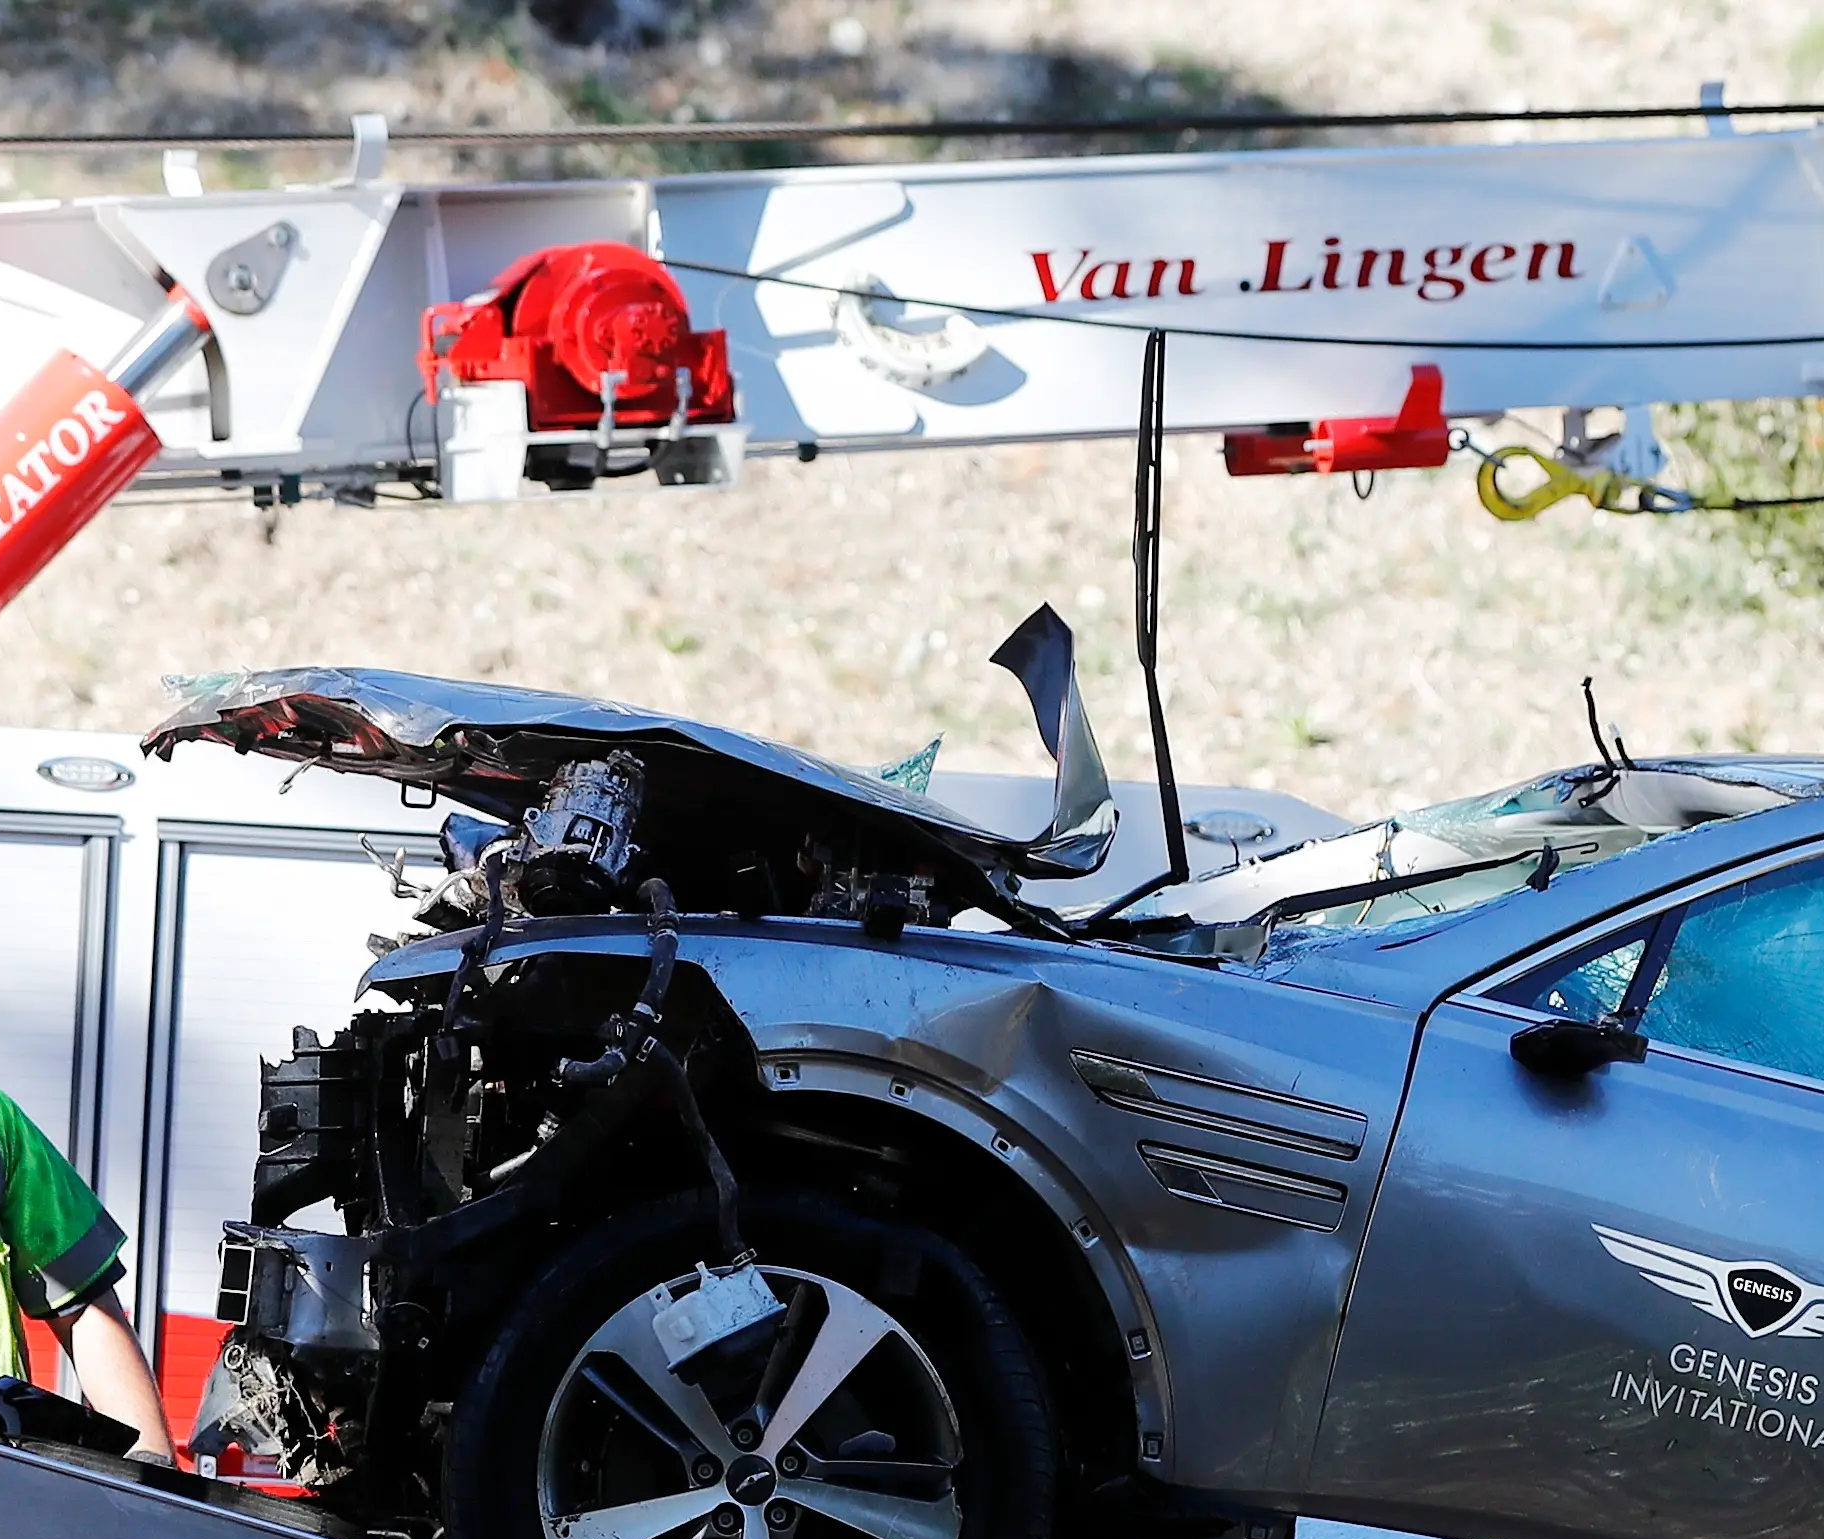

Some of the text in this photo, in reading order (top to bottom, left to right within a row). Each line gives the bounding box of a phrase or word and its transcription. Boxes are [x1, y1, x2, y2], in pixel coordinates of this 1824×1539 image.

[1030, 238, 1584, 302] Van Lingen
[1732, 1277, 1794, 1303] GENESIS
[1669, 1343, 1820, 1406] GENESIS
